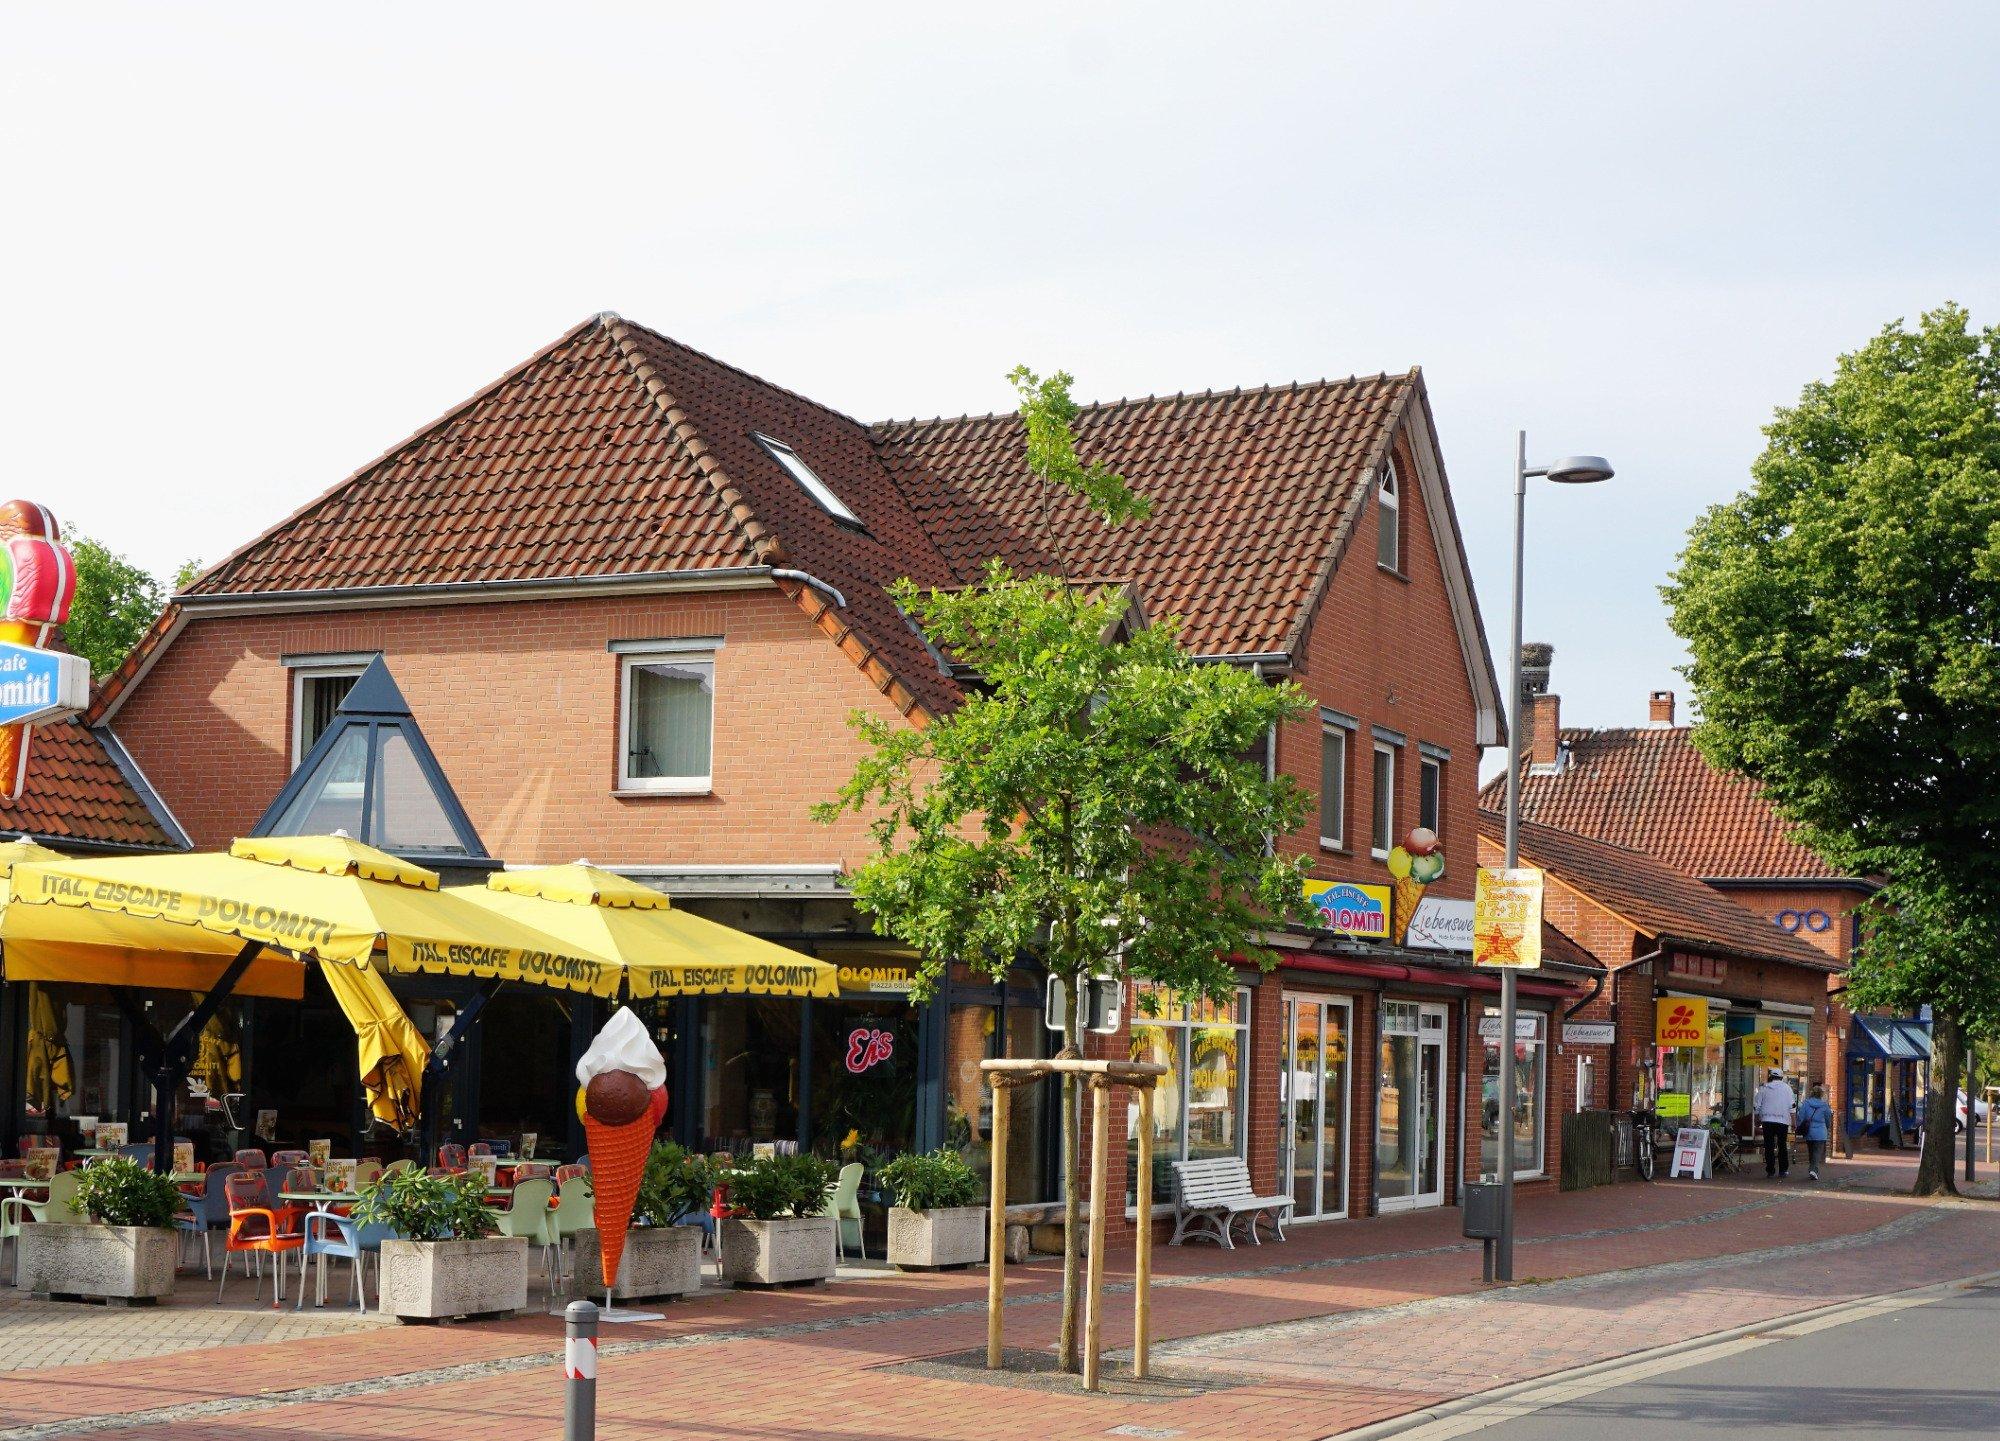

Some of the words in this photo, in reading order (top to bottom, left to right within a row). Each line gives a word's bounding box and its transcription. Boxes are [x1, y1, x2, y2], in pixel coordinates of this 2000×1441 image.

[0, 671, 50, 707] miti
[42, 874, 89, 897] ITAL.
[94, 881, 182, 911] EISCAFE
[199, 895, 337, 945] DOLOMITI
[1319, 906, 1385, 932] OLOMITI
[1410, 903, 1474, 933] Liebenswe
[411, 942, 448, 962] ITAL.
[449, 944, 511, 968] EISCAFE
[518, 948, 601, 983] DOLOMITI
[650, 968, 681, 988] ITAL.
[745, 965, 817, 987] DOLOMITI
[837, 967, 907, 982] OLOMITI
[1565, 1025, 1611, 1037] Liebenswert
[1661, 1029, 1700, 1040] LOTTO
[845, 1028, 894, 1073] Eis
